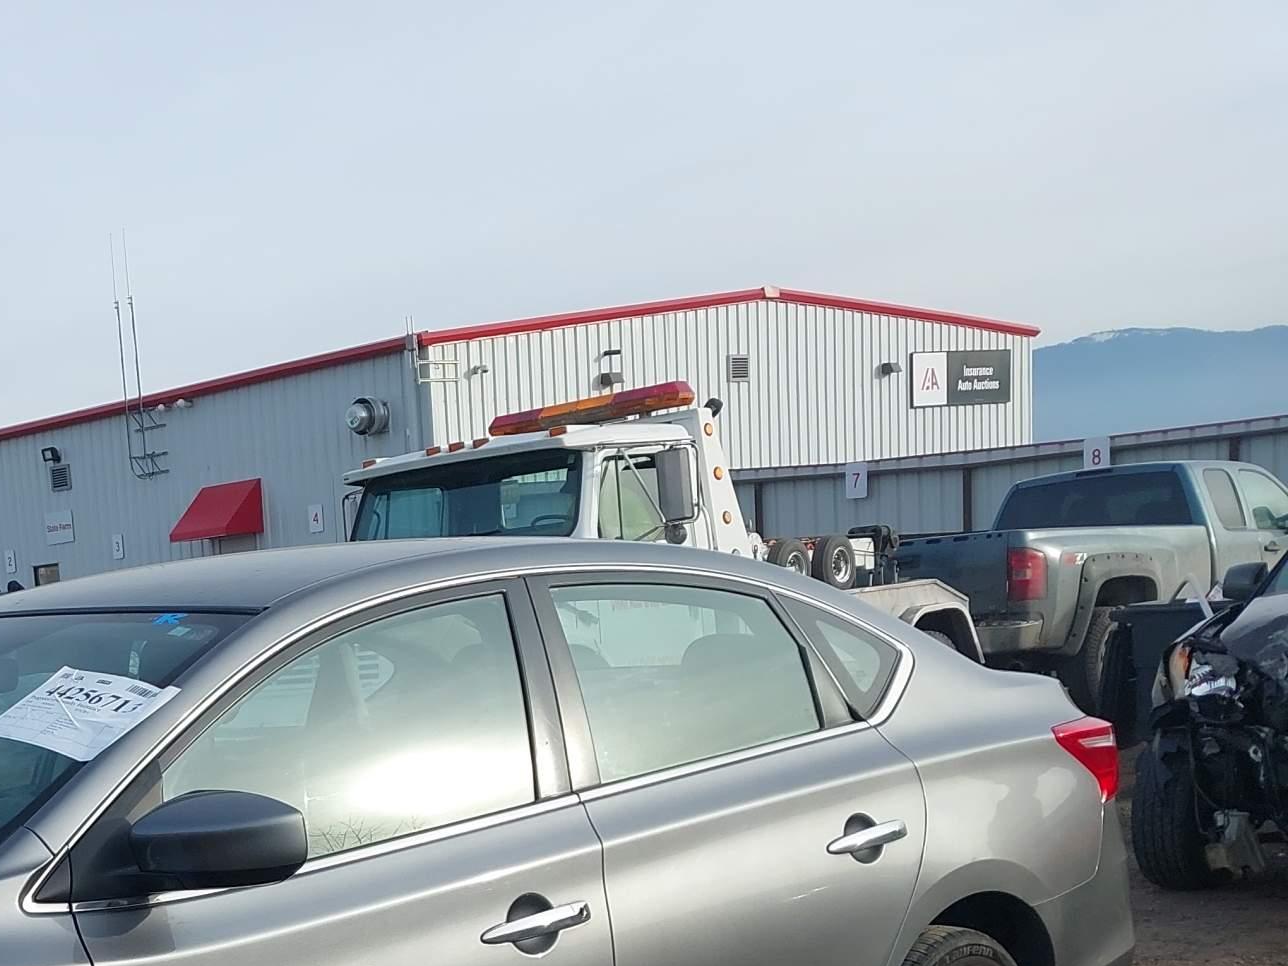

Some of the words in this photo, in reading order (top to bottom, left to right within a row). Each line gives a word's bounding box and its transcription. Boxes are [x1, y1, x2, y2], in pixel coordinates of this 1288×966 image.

[963, 364, 994, 377] Insurance
[957, 379, 972, 391] Auto
[973, 377, 1000, 390] Auctions
[1092, 448, 1102, 465] 8
[852, 472, 861, 489] 7
[312, 511, 319, 525] 4
[115, 541, 121, 553] 3
[7, 556, 13, 567] 2
[45, 684, 143, 714] 44256713
